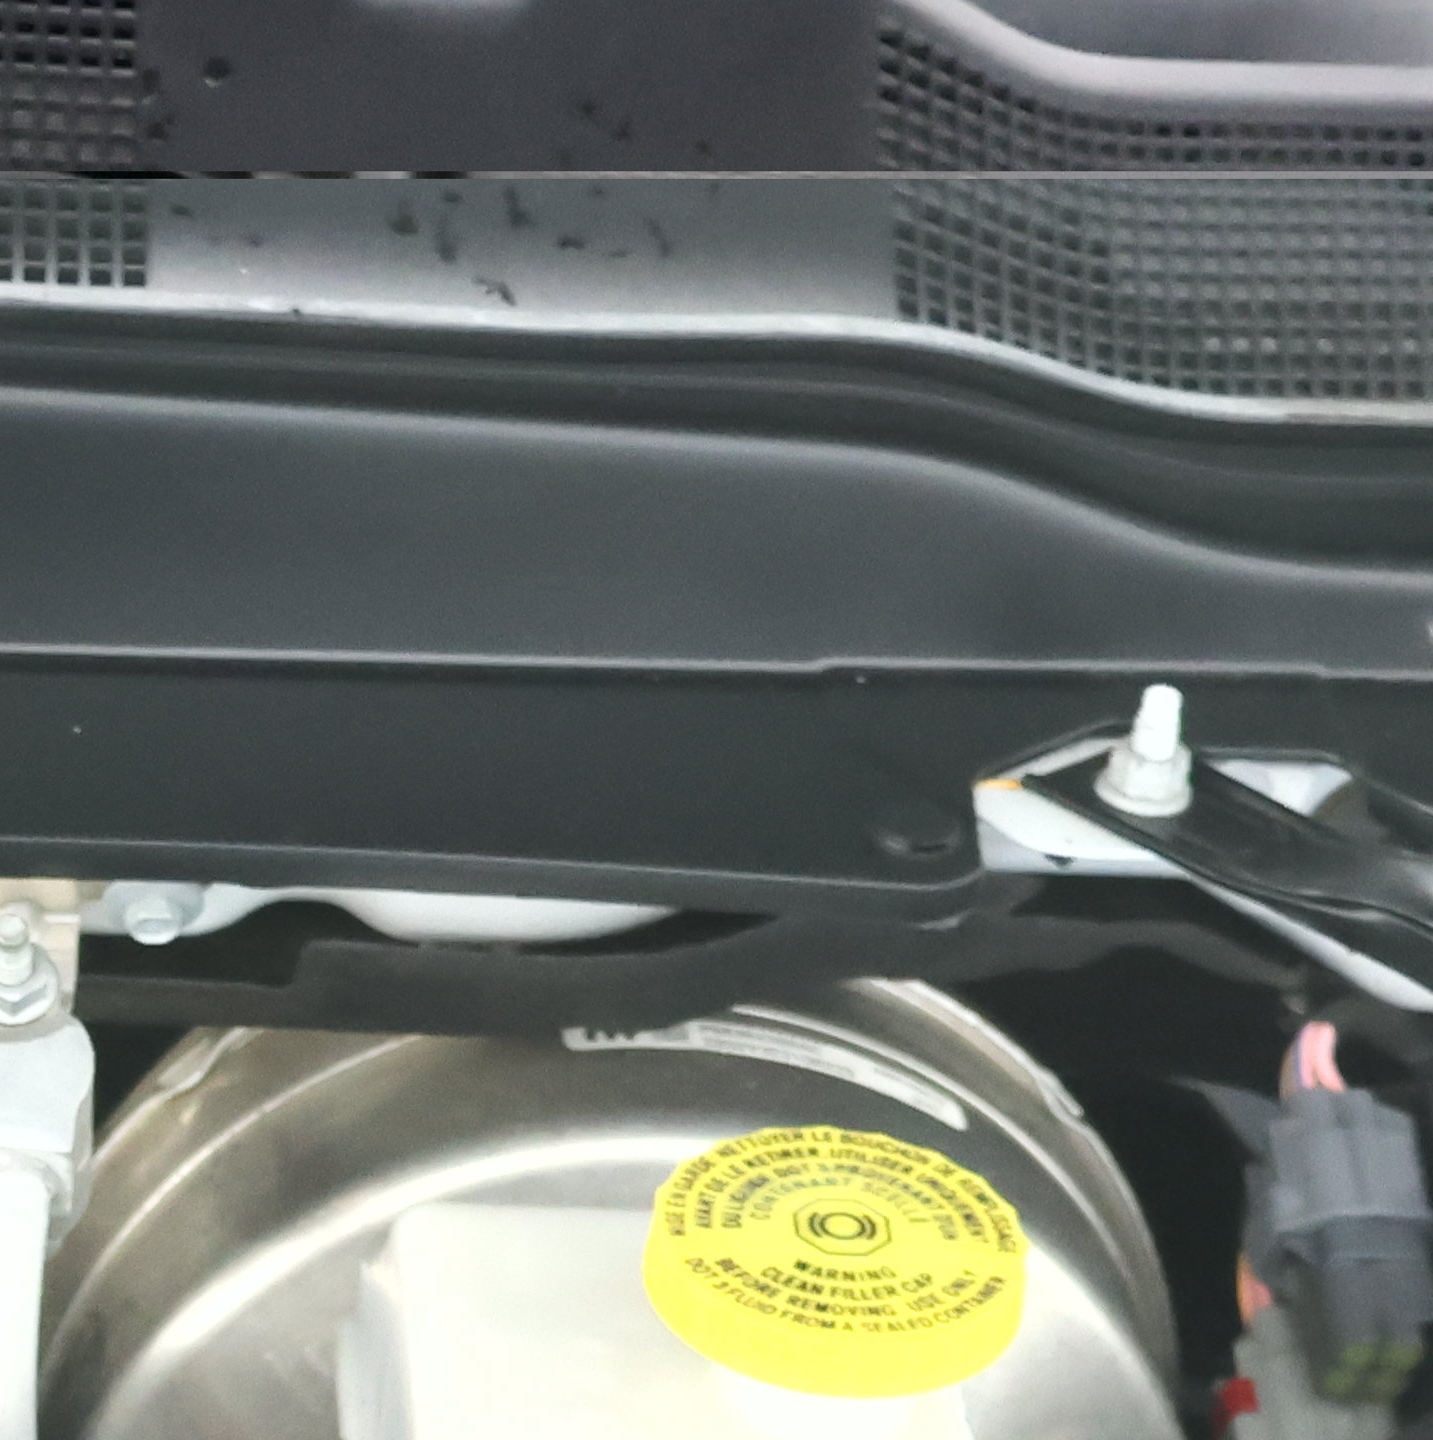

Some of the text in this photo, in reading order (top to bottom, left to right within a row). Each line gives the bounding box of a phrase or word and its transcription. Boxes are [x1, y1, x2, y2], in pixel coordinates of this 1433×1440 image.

[716, 1131, 804, 1158] NETTOYER
[811, 1131, 833, 1143] LE
[840, 1132, 931, 1165] BOUCHON
[742, 1146, 820, 1167] RETIRER
[830, 1147, 914, 1175] UTILISER
[714, 1257, 978, 1317] BEFORE REMOVING USE ONLY
[761, 1266, 933, 1301] CLEAN FILLER CAP
[794, 1258, 897, 1282] WARNING
[684, 1257, 719, 1279] DOT
[725, 1287, 778, 1315] FLUID
[779, 1308, 836, 1330] FROM
[842, 1320, 853, 1332] A
[861, 1316, 934, 1332] SEALED
[933, 1275, 1007, 1325] CONTAINER
